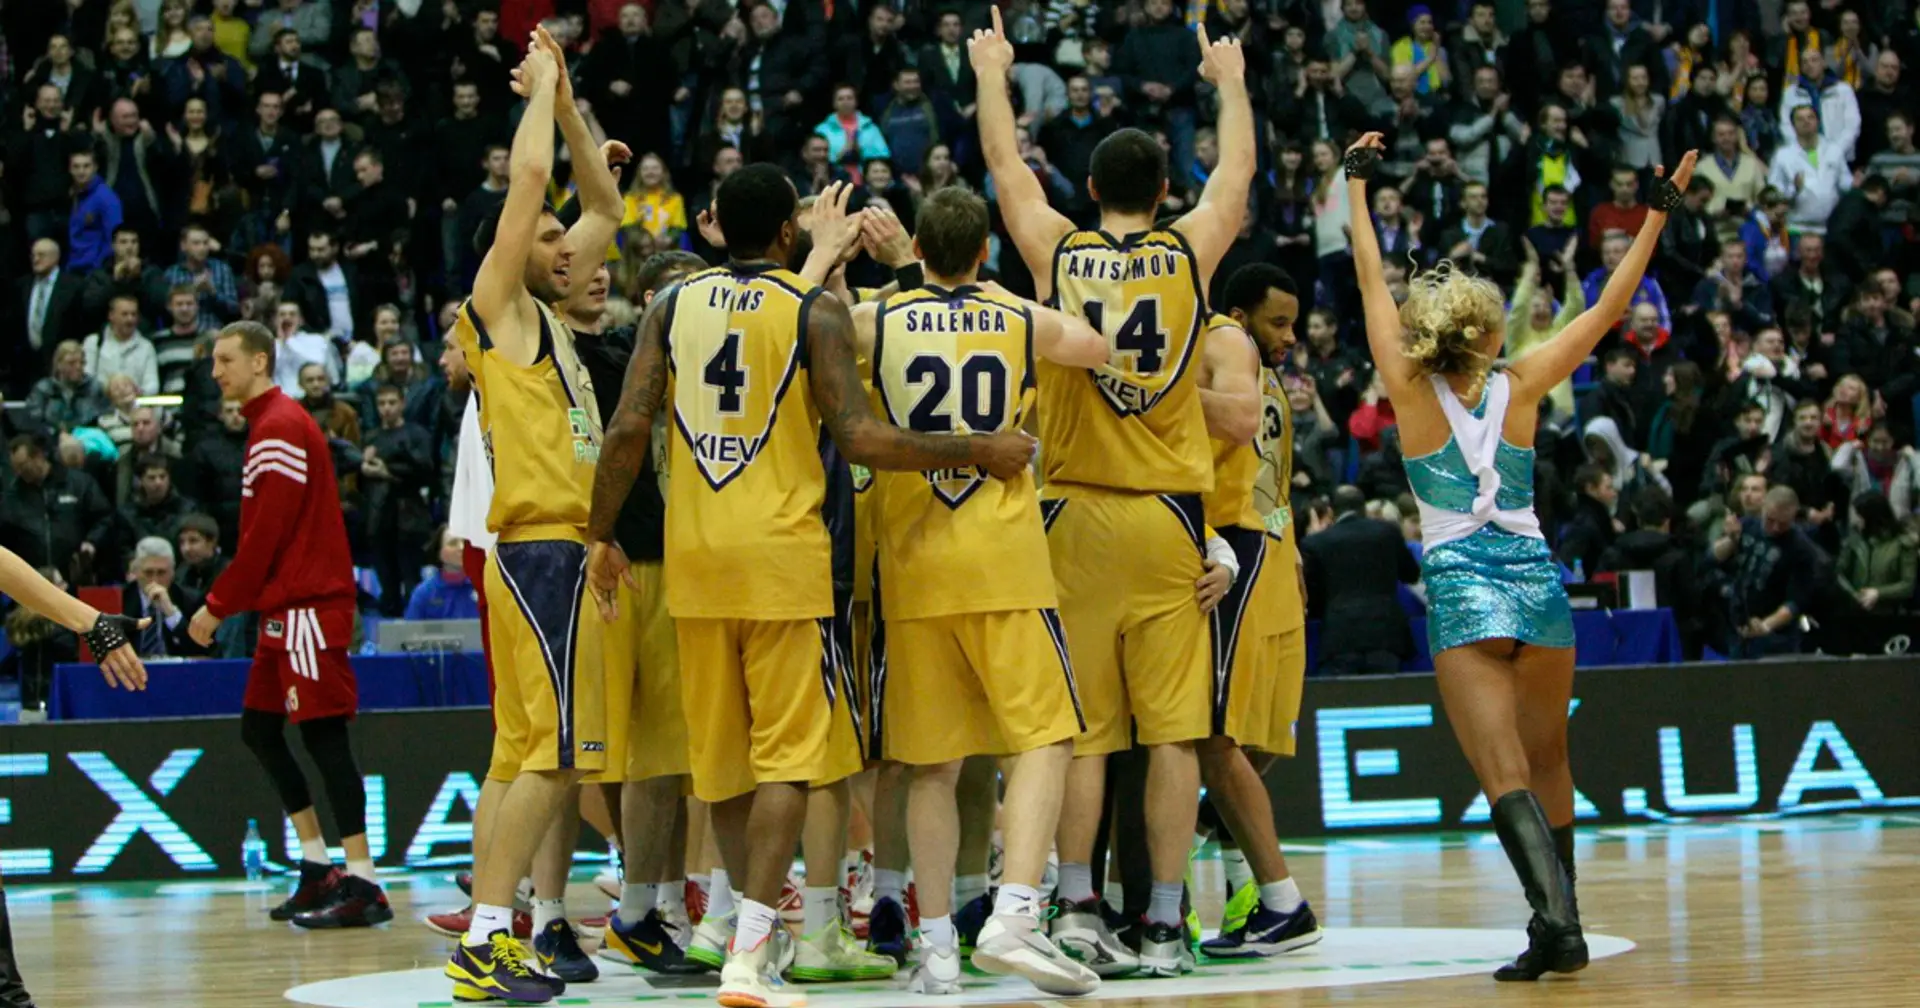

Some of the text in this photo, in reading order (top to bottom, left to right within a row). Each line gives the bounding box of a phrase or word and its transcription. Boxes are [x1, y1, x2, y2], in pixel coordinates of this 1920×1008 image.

[906, 309, 1006, 333] SALENGA
[702, 332, 746, 413] 4
[904, 354, 1007, 432] 20
[694, 432, 760, 462] KIEV
[1262, 405, 1281, 441] 3
[1315, 703, 1884, 827] E.UA
